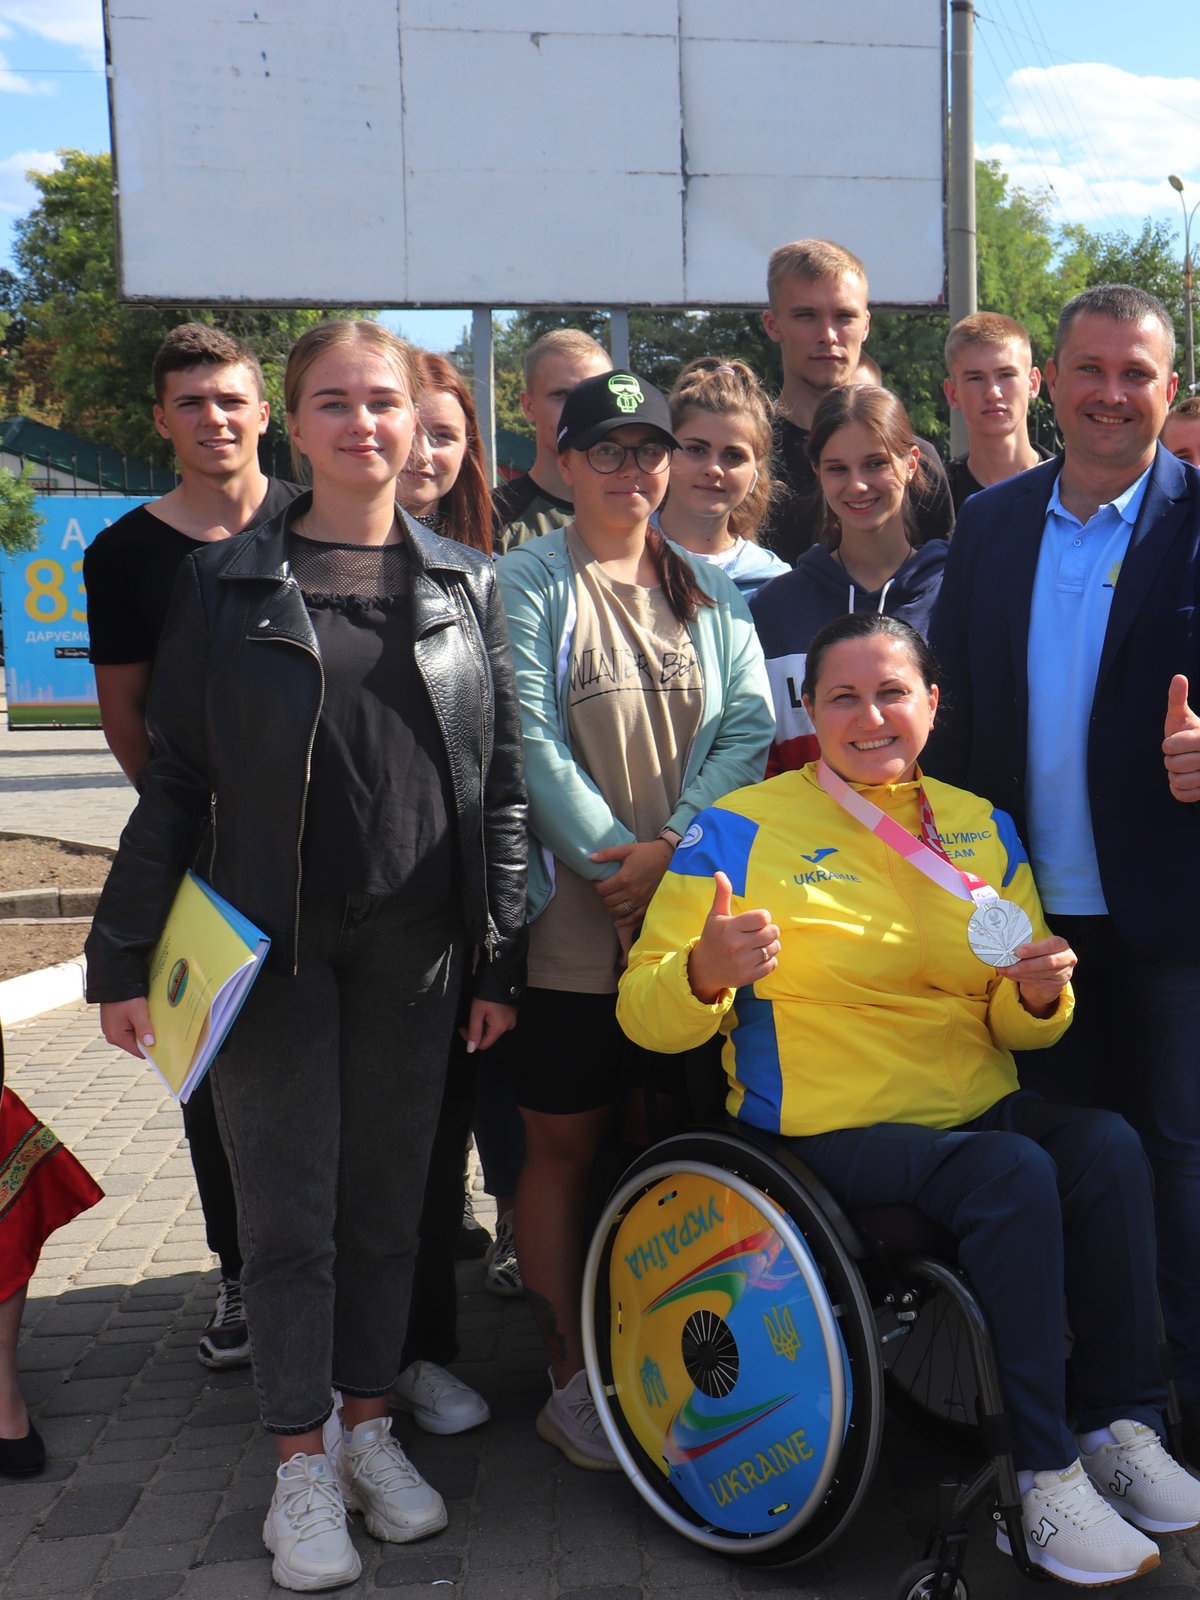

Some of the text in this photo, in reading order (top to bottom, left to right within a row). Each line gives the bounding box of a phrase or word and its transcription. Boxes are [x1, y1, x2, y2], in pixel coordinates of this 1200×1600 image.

[793, 869, 861, 885] UKRAINE
[946, 848, 975, 860] EAM
[625, 1196, 725, 1280] УКРАЇНА
[708, 1429, 814, 1508] UKRAINE
